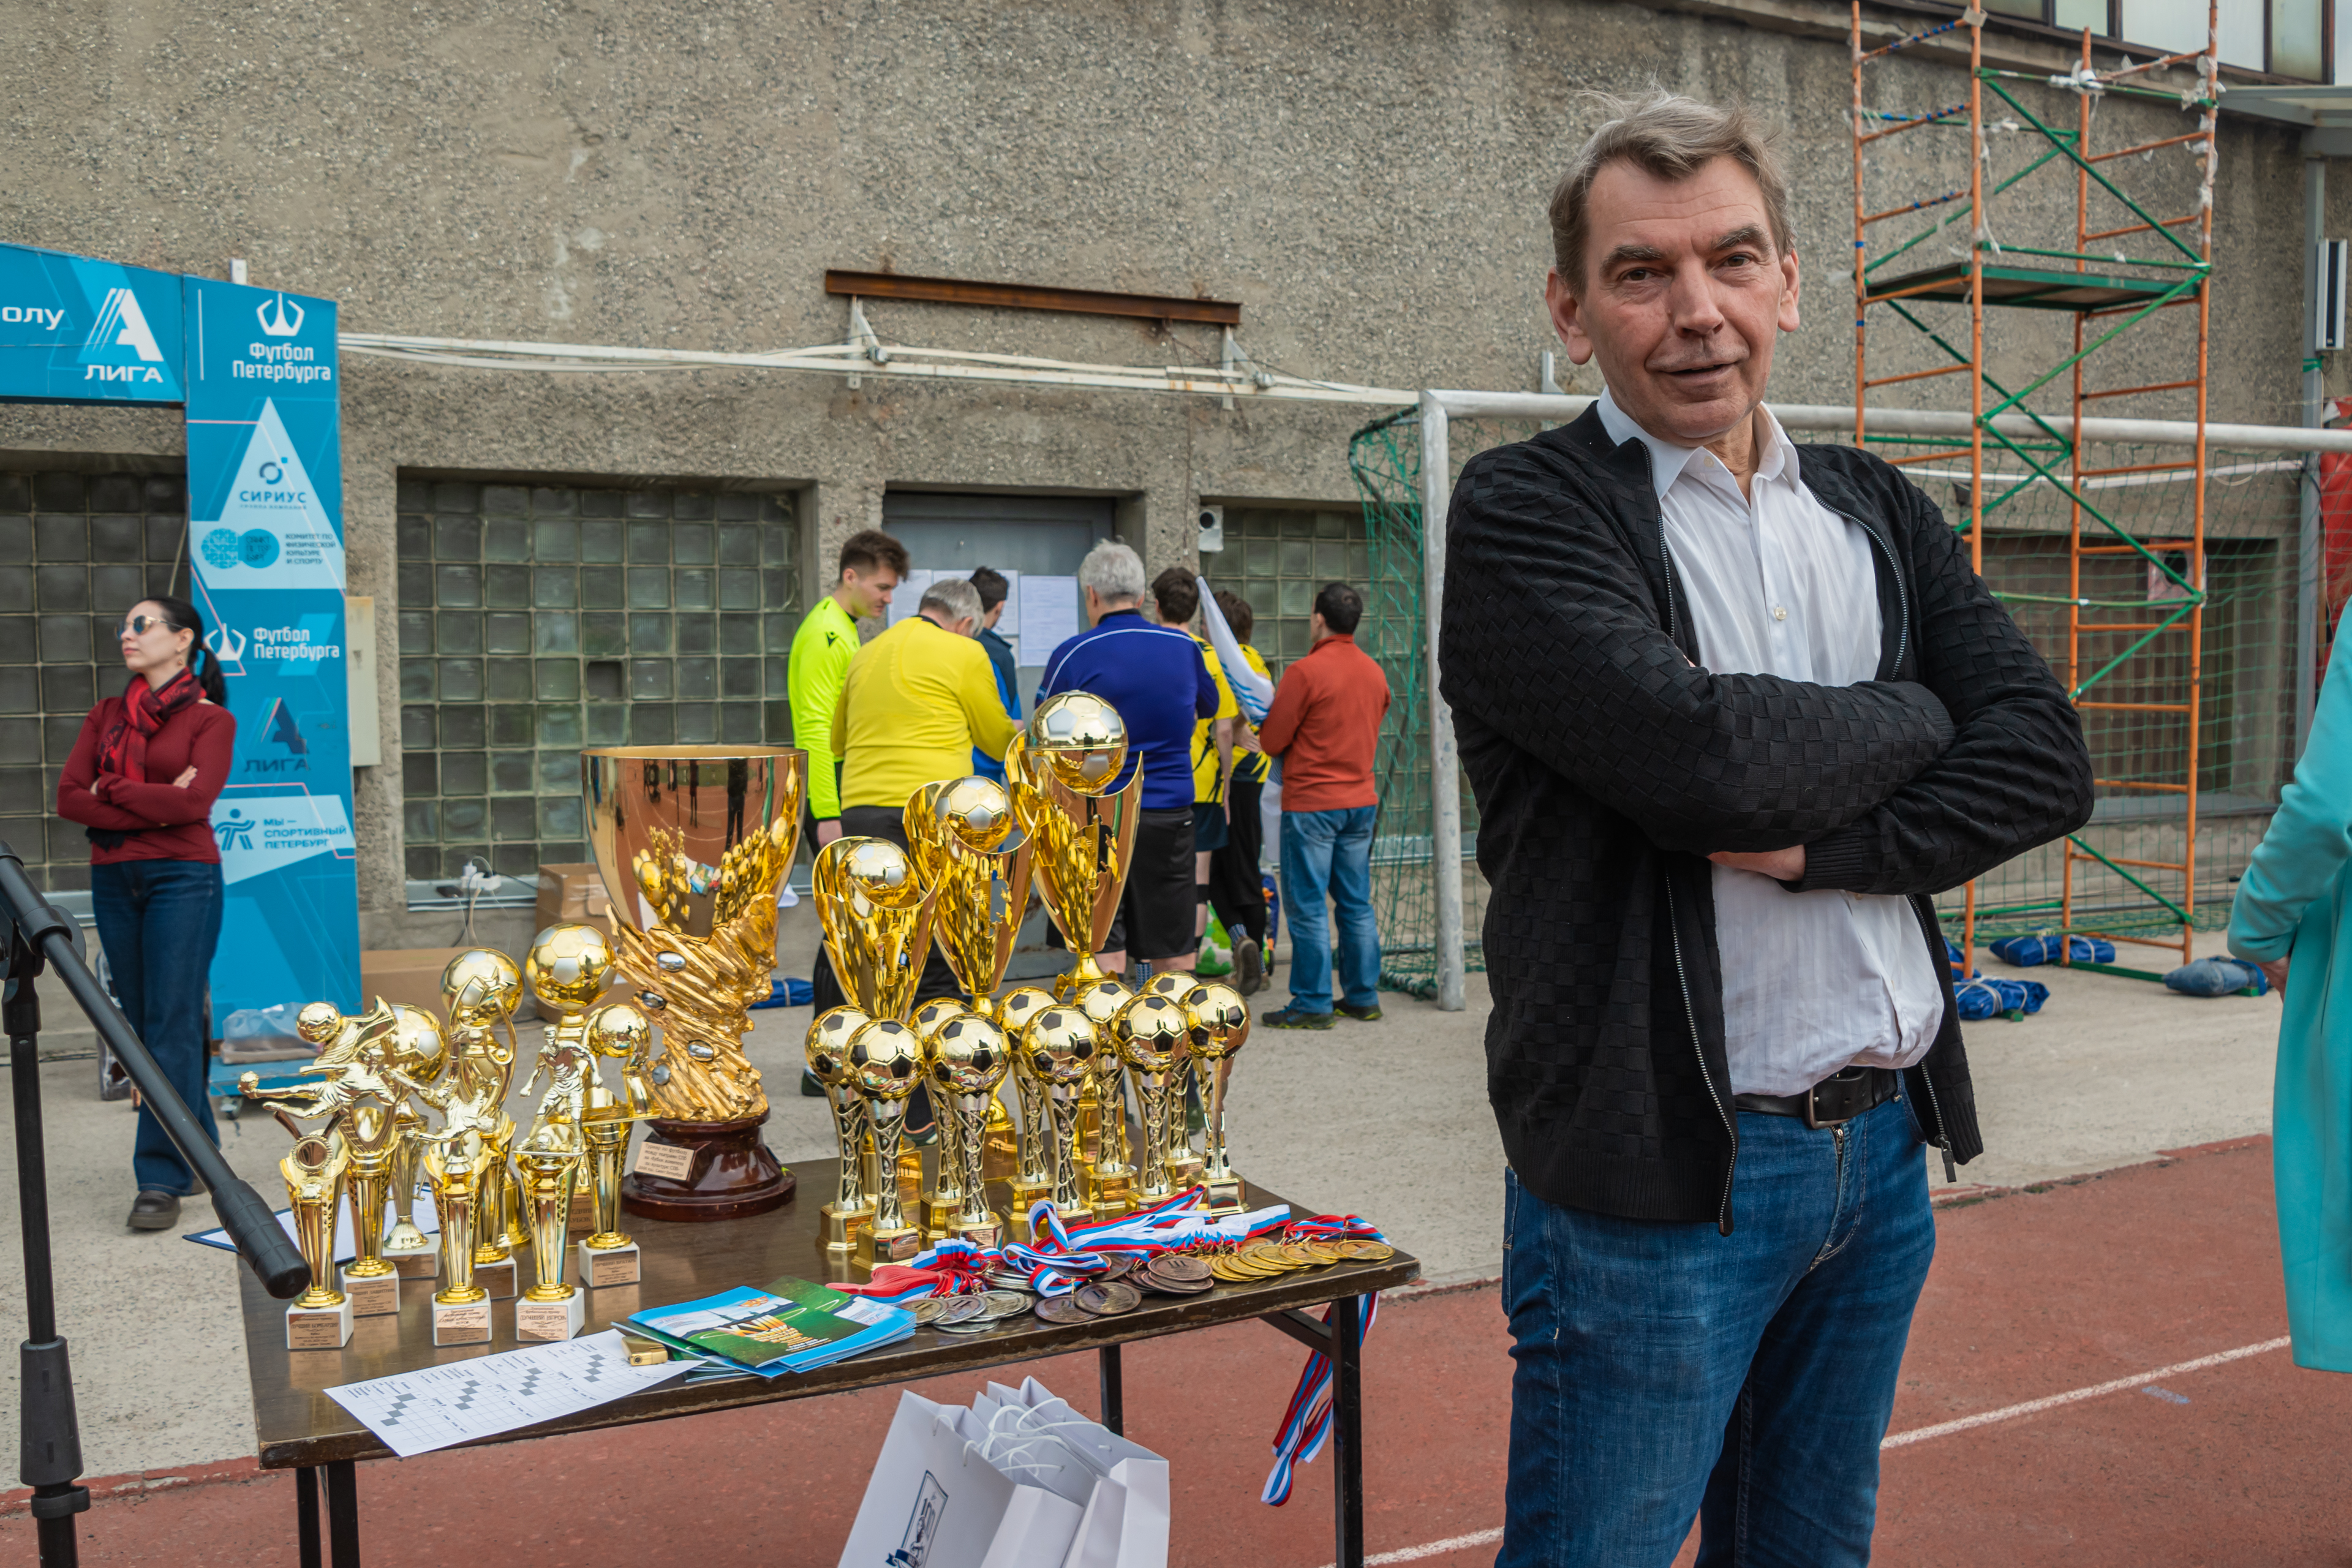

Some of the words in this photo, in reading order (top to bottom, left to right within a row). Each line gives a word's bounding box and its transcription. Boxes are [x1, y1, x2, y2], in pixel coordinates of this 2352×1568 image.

[249, 342, 314, 364] Футбол
[84, 364, 164, 383] ЛИГА
[232, 360, 331, 384] Петербурга
[239, 491, 306, 503] СИРИУС
[254, 627, 310, 645] Футбол
[254, 643, 340, 662] Петербурга
[245, 758, 311, 772] ЛИГА
[264, 826, 347, 838] СПОРТИВНЫЙ
[265, 838, 330, 850] ПЕТЕРБУРГ
